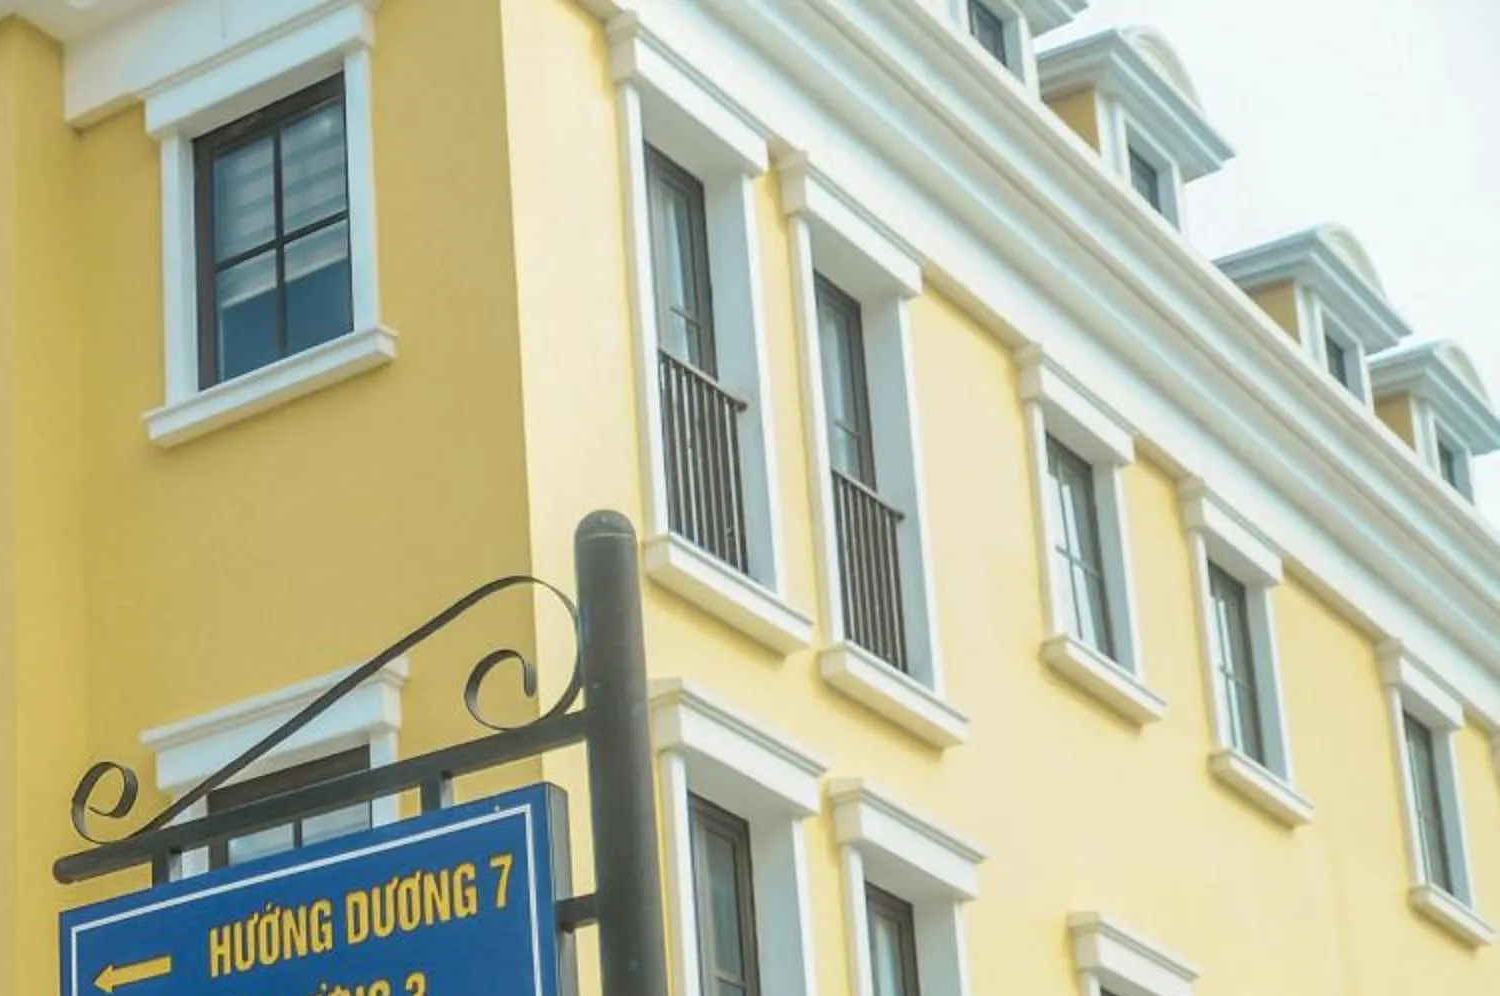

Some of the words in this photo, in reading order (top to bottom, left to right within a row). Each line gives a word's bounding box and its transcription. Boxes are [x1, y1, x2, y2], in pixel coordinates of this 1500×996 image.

[209, 900, 334, 978] HƯỚNG
[346, 862, 479, 946] DƯƠNG
[489, 853, 514, 908] 7
